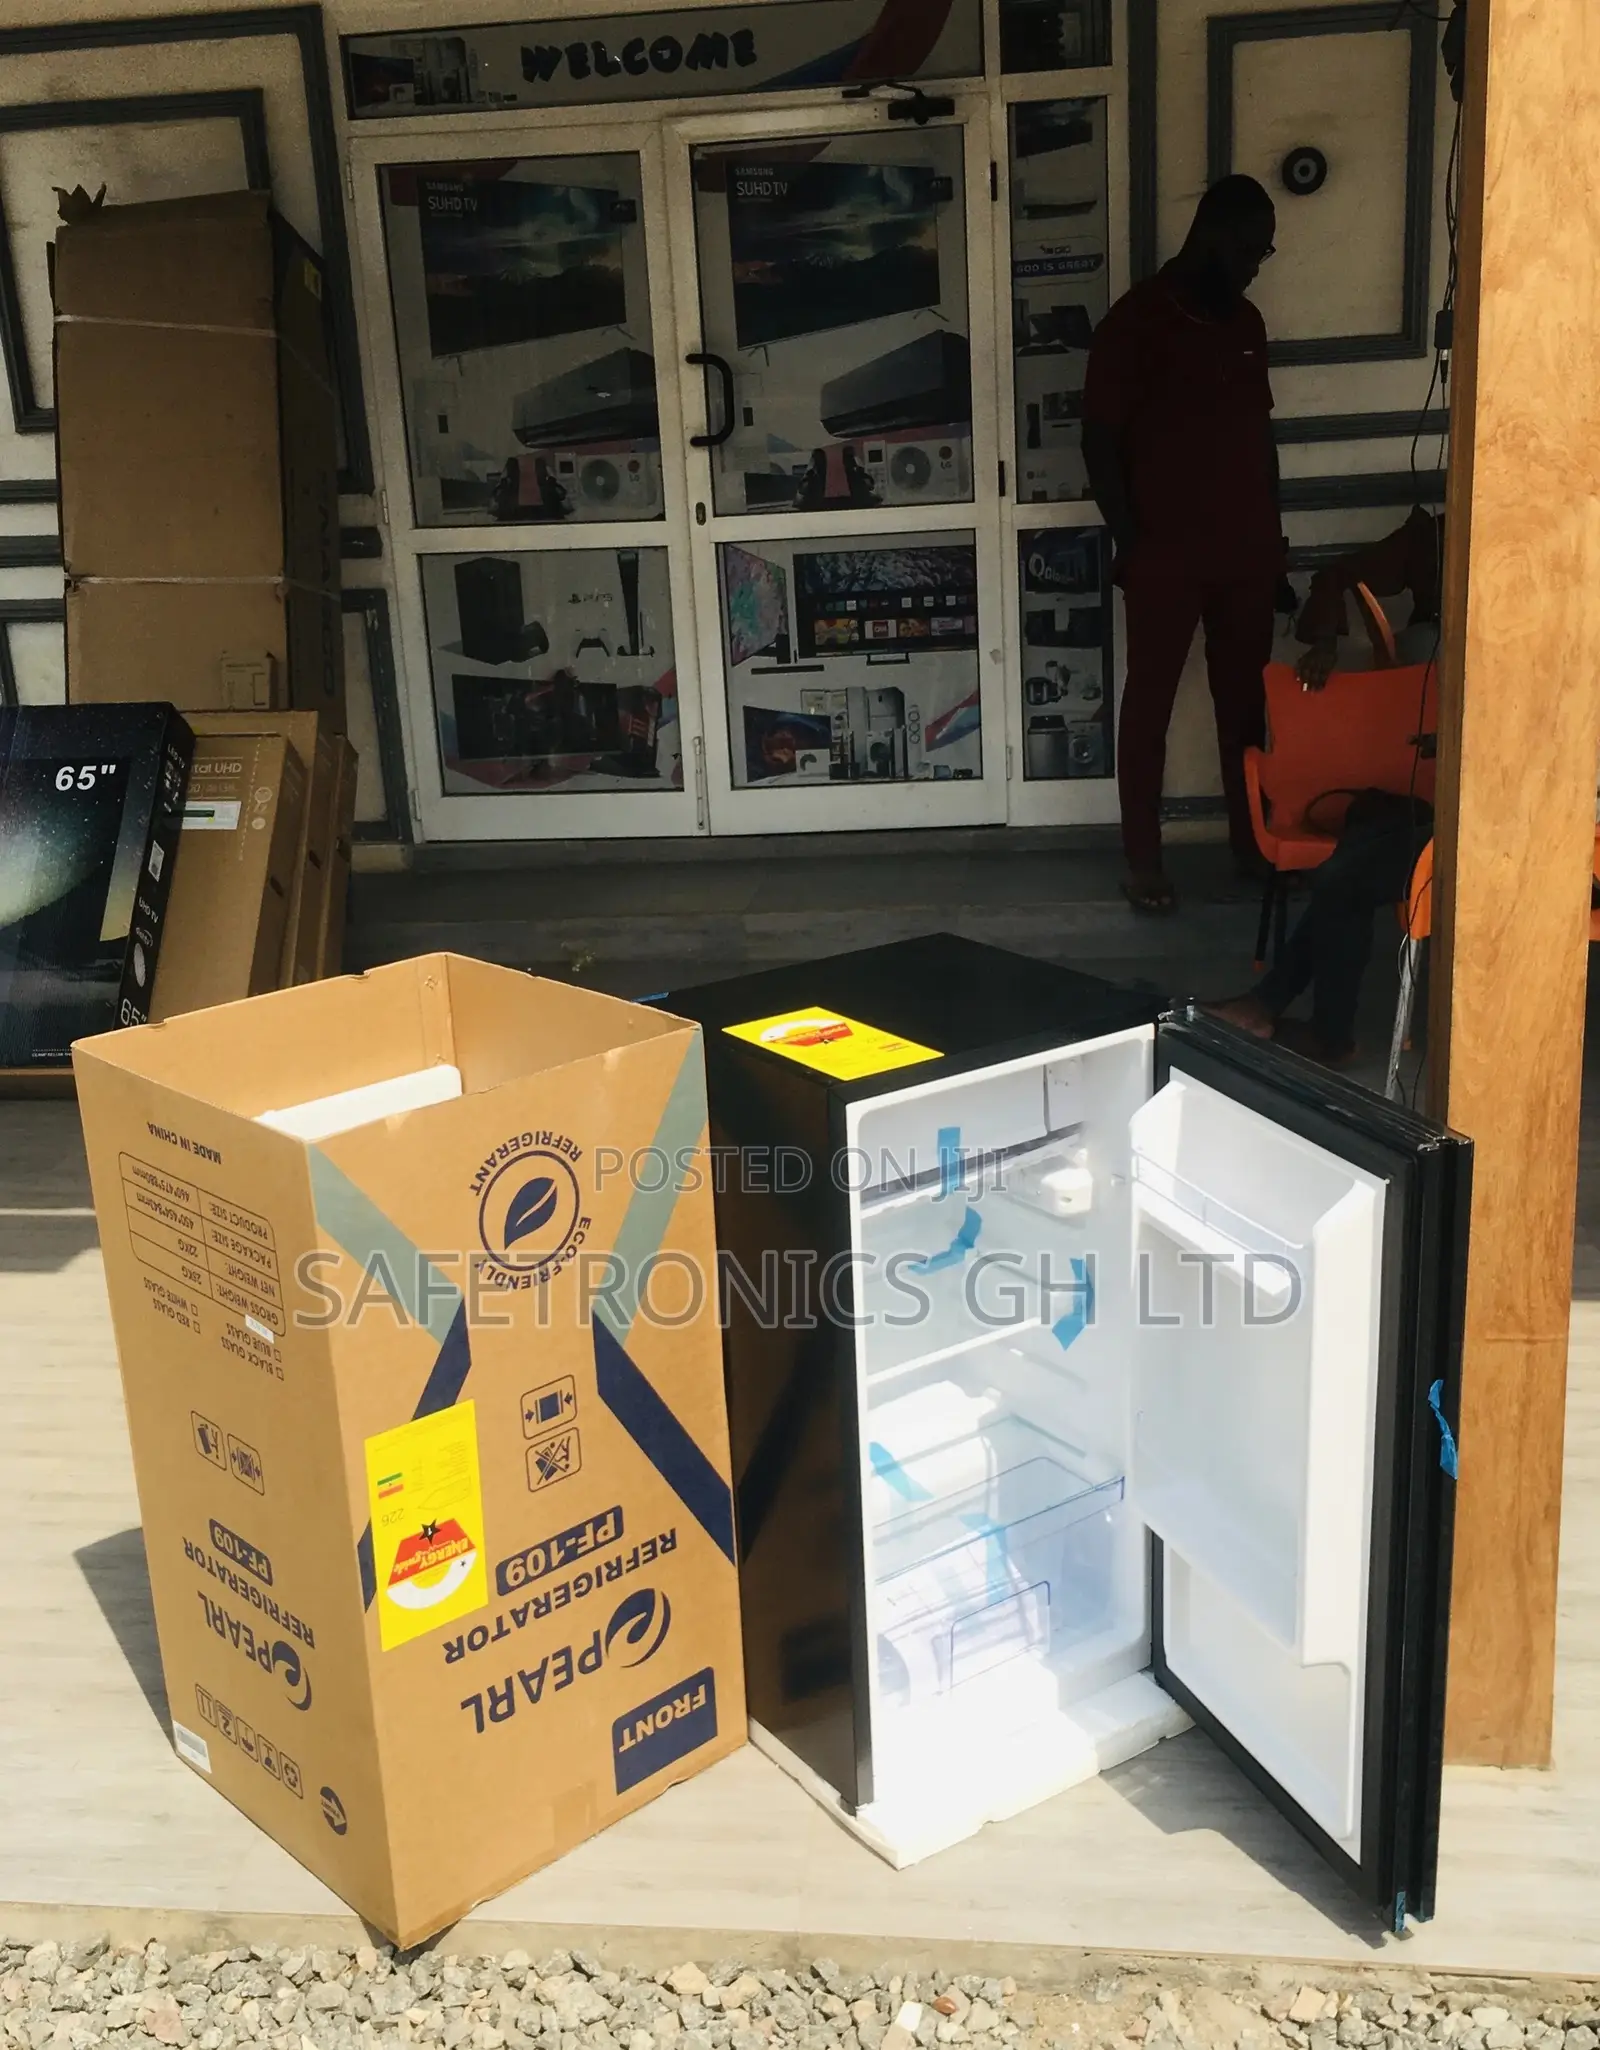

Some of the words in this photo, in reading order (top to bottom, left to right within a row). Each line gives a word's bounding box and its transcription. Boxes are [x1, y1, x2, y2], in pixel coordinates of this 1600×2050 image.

[520, 28, 757, 84] WELCOME
[735, 166, 774, 177] SAMSUNG
[736, 181, 771, 197] SUHD
[772, 180, 789, 197] TV
[427, 196, 462, 212] SUHD
[463, 196, 478, 213] TV
[1016, 263, 1040, 274] GOD
[1043, 261, 1054, 271] IS
[1058, 259, 1096, 270] GREAT
[54, 764, 117, 792] 65"
[214, 762, 242, 774] UHD
[120, 997, 147, 1026] 65"
[146, 1121, 178, 1148] CHINA
[179, 1135, 191, 1152] IN
[191, 1140, 221, 1165] MADE
[468, 1130, 584, 1197] REFRIGERANT
[229, 1211, 268, 1240] PRODUCT
[230, 1238, 272, 1269] PACKAGE
[143, 1276, 166, 1298] GLASS
[260, 1280, 275, 1298] NET
[152, 1298, 175, 1319] GLASS
[167, 1291, 189, 1311] WHITE
[250, 1301, 279, 1326] GROSS
[176, 1311, 191, 1328] RED
[225, 1322, 251, 1346] GLASS
[220, 1336, 246, 1359] GLASS
[247, 1352, 274, 1375] BLACK
[213, 1524, 269, 1580] PF-109
[418, 1538, 469, 1570] ENERGY
[504, 1512, 617, 1586] PF-109
[182, 1536, 316, 1650] REFRIGERATOR
[442, 1527, 678, 1665] REFRIGERATOR
[196, 1590, 274, 1675] PEARL
[460, 1629, 604, 1735] PEARL
[617, 1683, 707, 1753] FRONT
